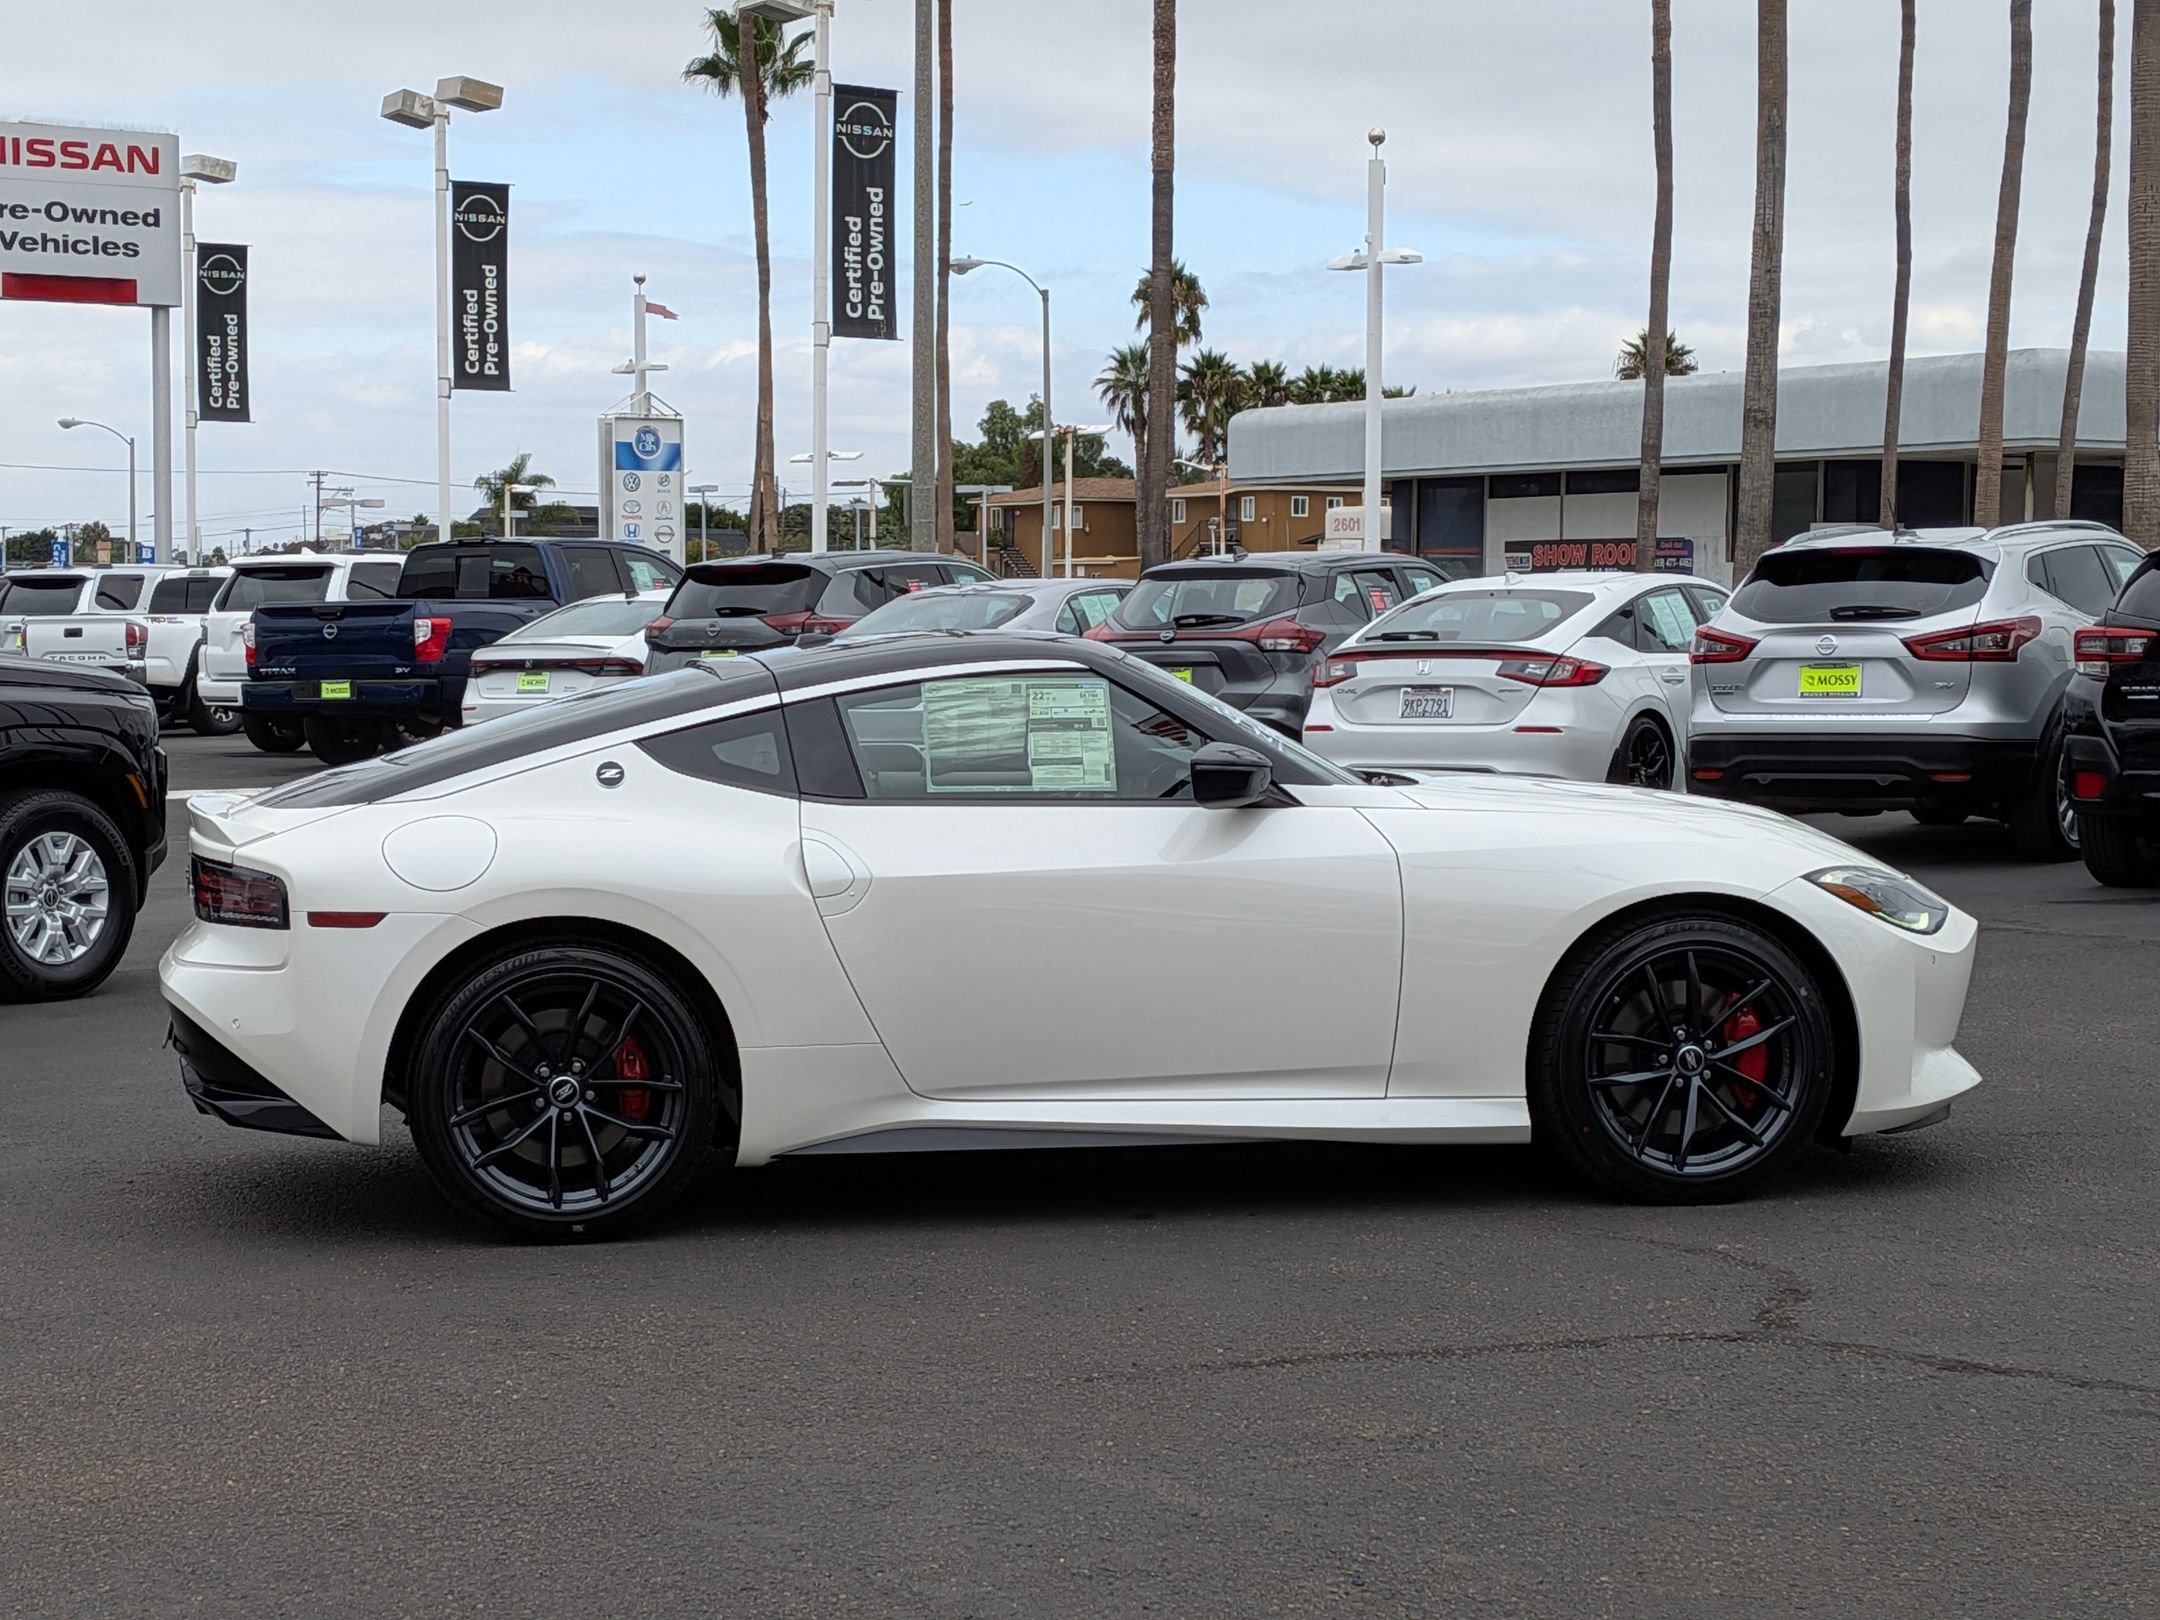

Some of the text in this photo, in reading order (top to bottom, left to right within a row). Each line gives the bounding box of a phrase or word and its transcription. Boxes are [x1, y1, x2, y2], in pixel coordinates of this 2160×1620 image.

[836, 123, 893, 137] NISSAN
[0, 136, 160, 175] ISSAN
[455, 212, 506, 224] NISSAN
[0, 230, 140, 258] Vehicles
[866, 187, 884, 321] Pre-Owned
[199, 269, 245, 280] NISSAN
[844, 216, 862, 318] Certified
[463, 289, 480, 374] Certified
[482, 264, 499, 376] Pre-Owned
[207, 334, 223, 408] Certified
[224, 314, 240, 409] Pre-Owned
[1333, 518, 1361, 531] 2601
[1532, 543, 1588, 567] SHOW
[1817, 674, 1858, 686] MOSSY
